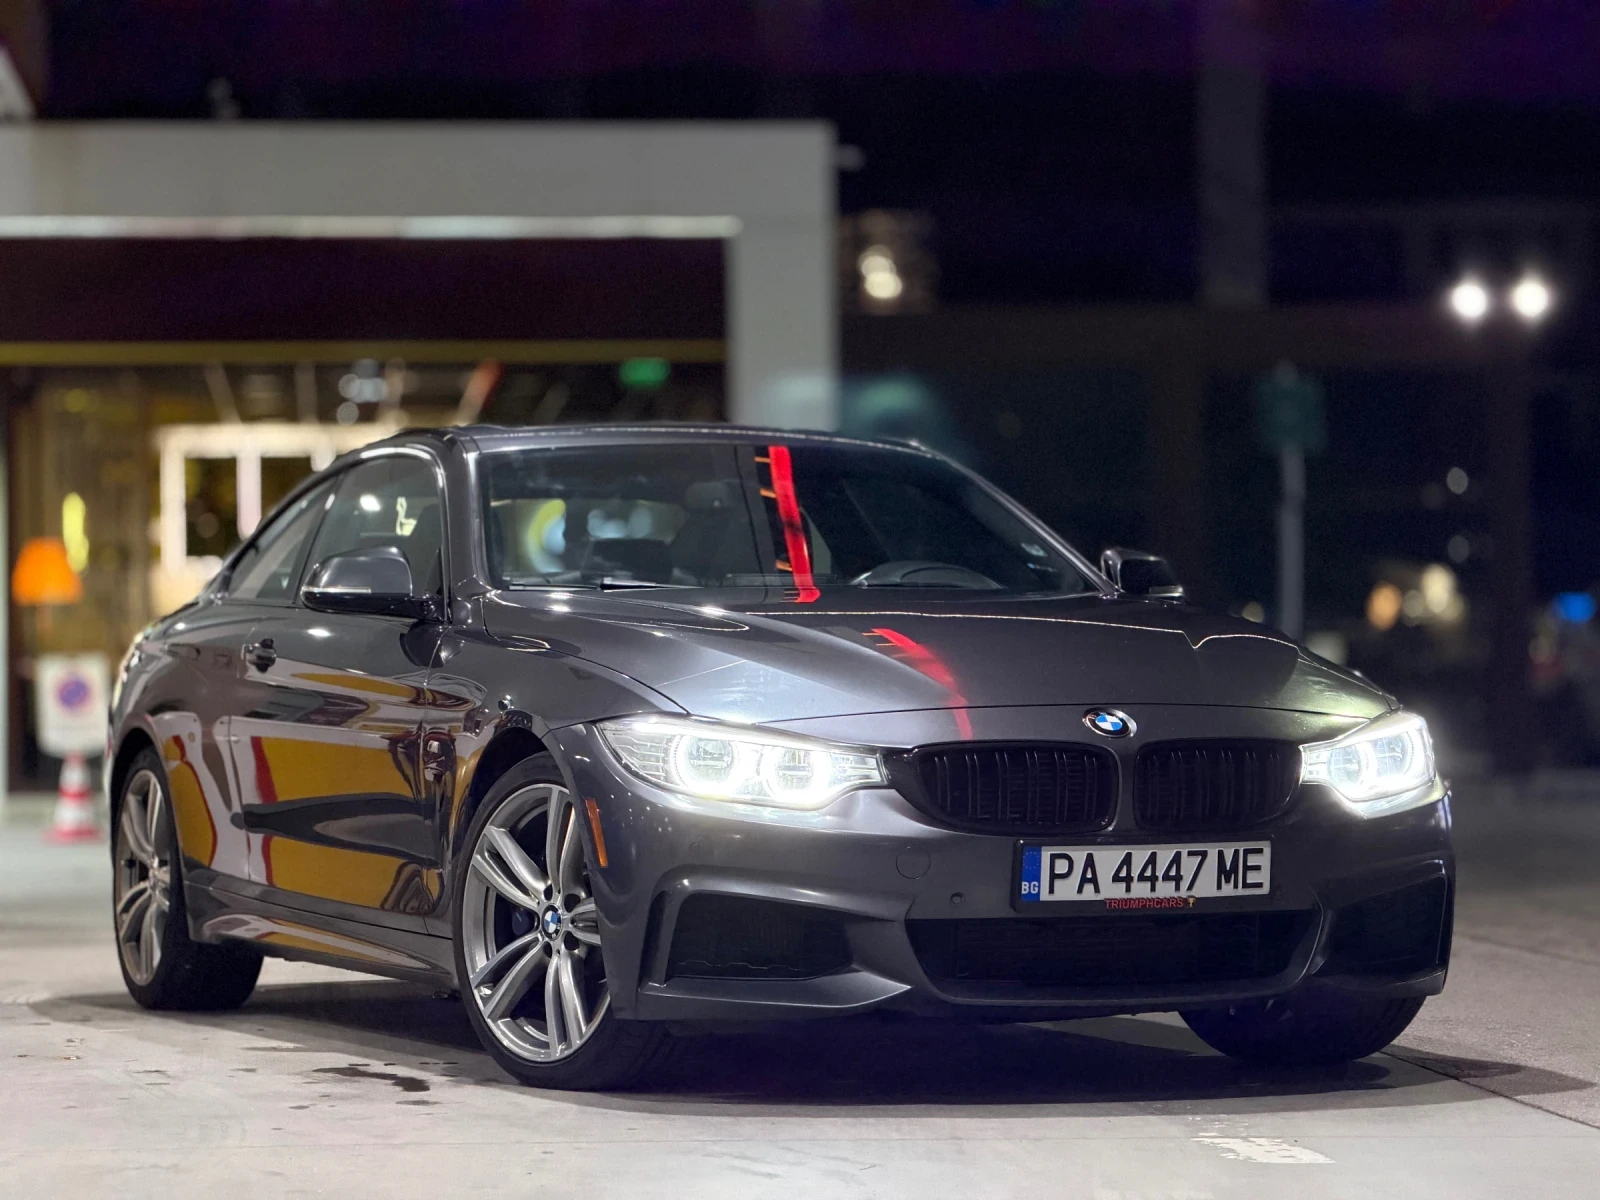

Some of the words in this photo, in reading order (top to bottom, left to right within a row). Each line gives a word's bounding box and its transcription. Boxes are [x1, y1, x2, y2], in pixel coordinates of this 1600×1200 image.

[1048, 852, 1101, 894] PA
[1111, 850, 1208, 892] 4447
[1216, 847, 1264, 890] ME
[1021, 881, 1039, 895] BG
[1104, 898, 1184, 909] TRIUMPHCARS
